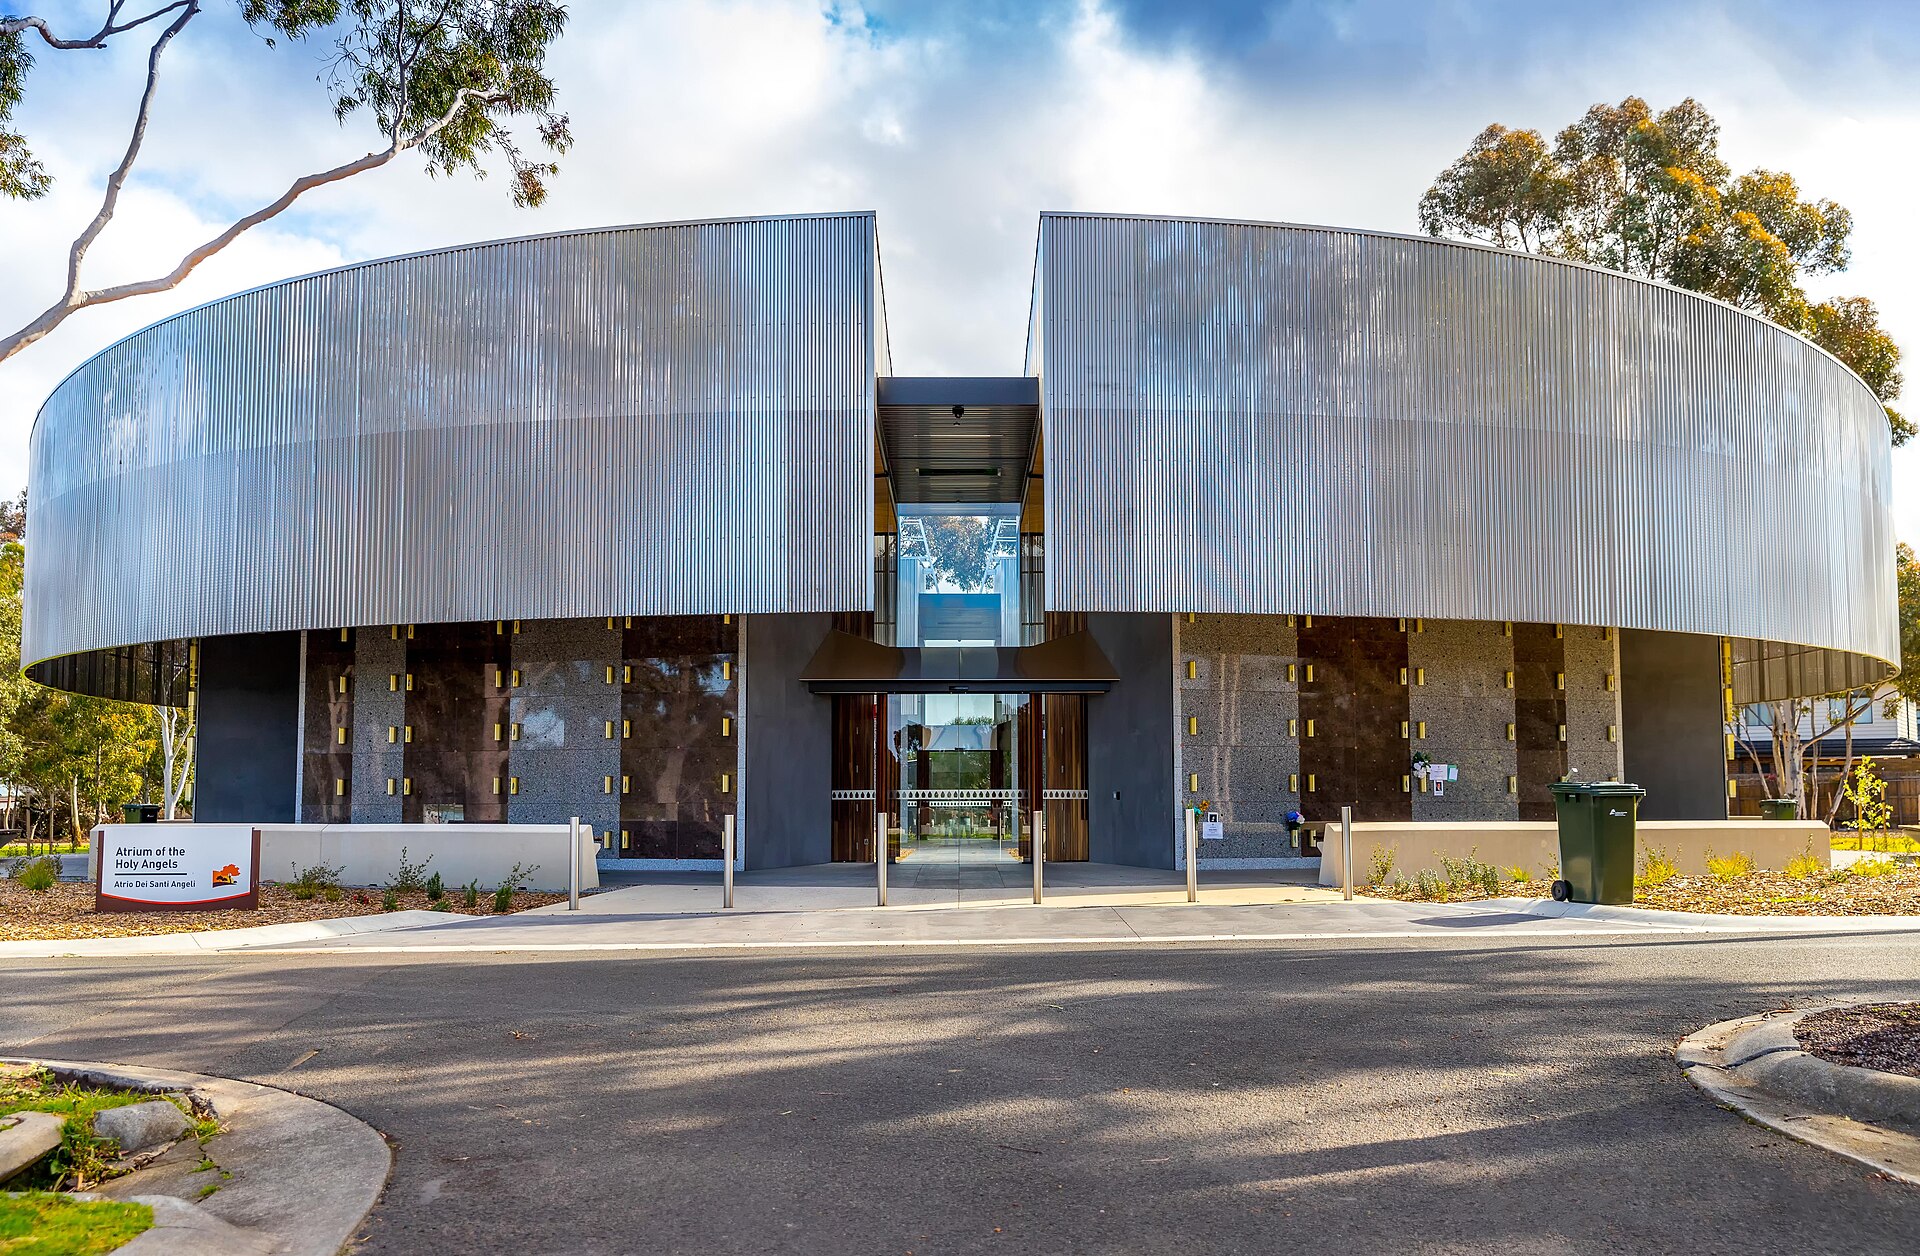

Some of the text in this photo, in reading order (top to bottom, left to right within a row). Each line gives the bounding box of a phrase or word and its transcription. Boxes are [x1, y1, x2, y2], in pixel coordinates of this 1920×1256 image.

[115, 846, 186, 857] Atrium of the
[115, 859, 178, 871] Holy Angels
[114, 880, 196, 890] Atrio Dei Santi Angeli
